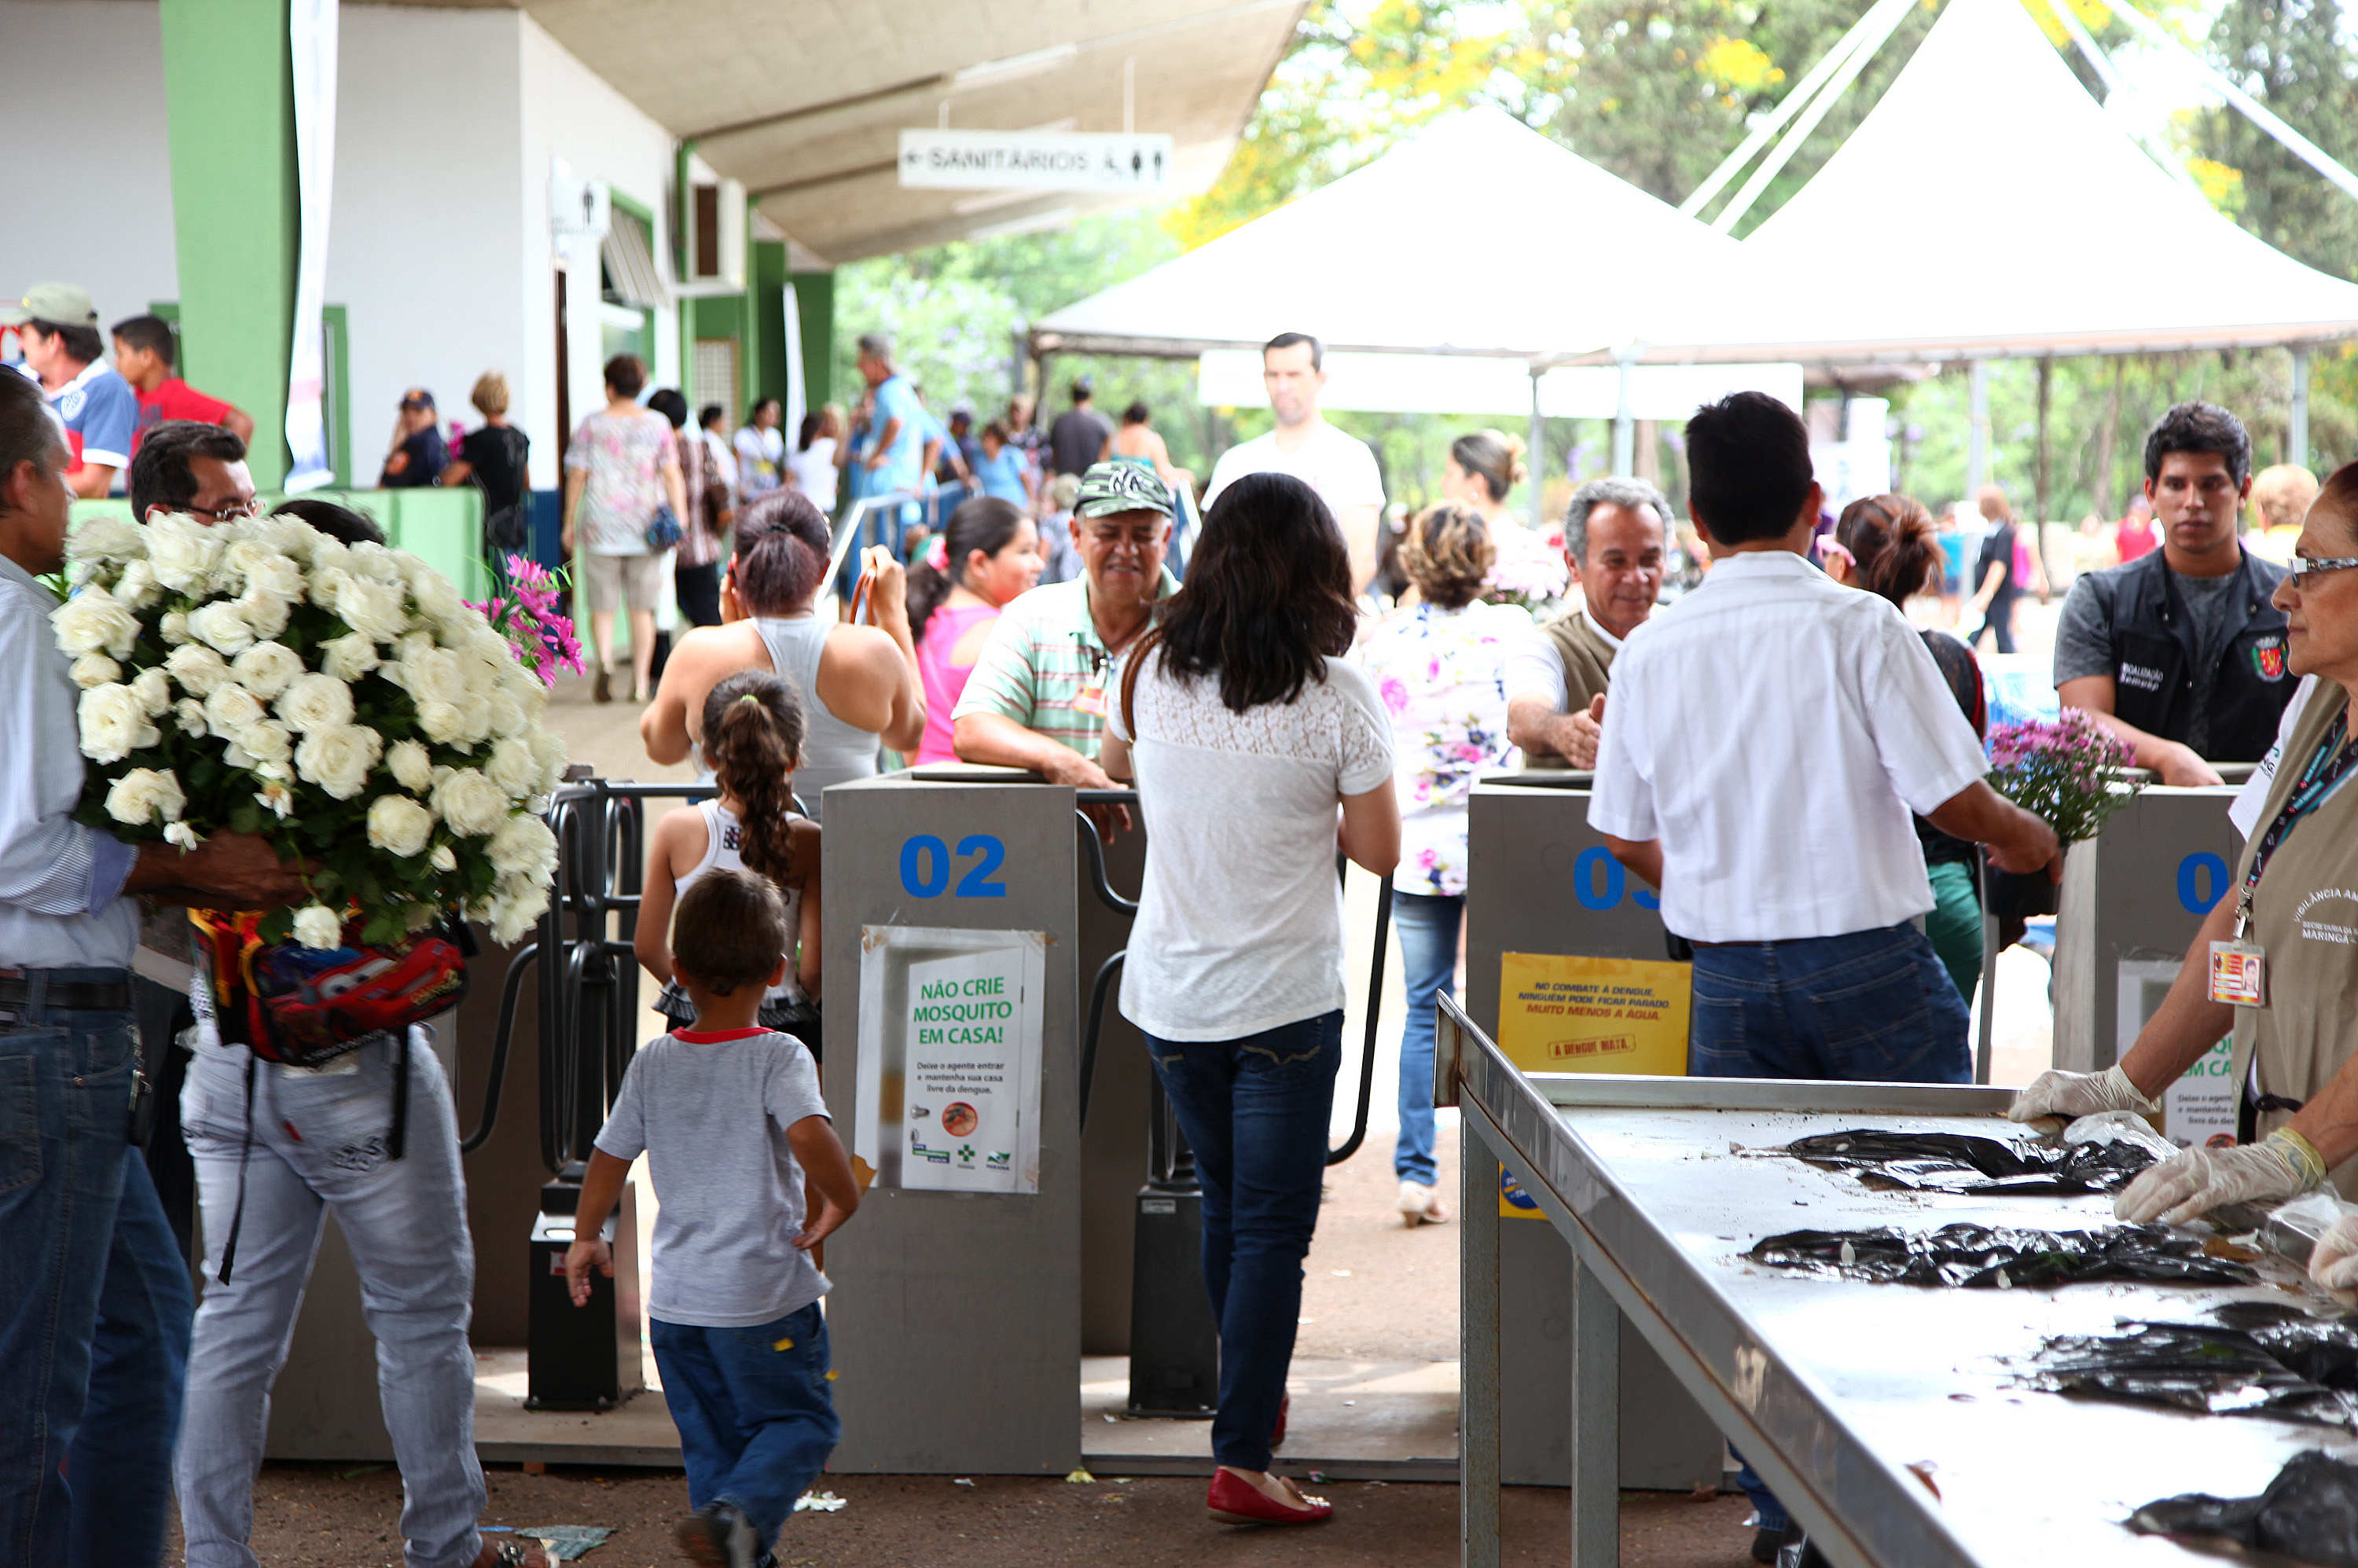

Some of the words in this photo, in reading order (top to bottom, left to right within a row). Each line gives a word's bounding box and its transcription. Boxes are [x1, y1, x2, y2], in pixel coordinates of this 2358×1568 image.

[928, 145, 1089, 170] SANITÁRIOS
[900, 834, 1006, 898] 02
[921, 979, 958, 1000] NÃO
[963, 976, 1005, 996] CRIE
[1535, 982, 1550, 990] NO
[1552, 982, 1600, 993] COMBATE
[1518, 992, 1566, 1002] NINGUÉM
[1569, 995, 1595, 1004] PODE
[1598, 997, 1626, 1006] FICAR
[913, 1001, 1012, 1023] MOSQUITO
[1526, 1004, 1564, 1014] MUITO
[1567, 1006, 1611, 1017] MENOS
[1614, 1009, 1622, 1019] A
[919, 1028, 943, 1045] EM
[948, 1026, 1003, 1044] CASA!
[1555, 1045, 1562, 1056] A
[1564, 1041, 1598, 1056] DENGUE
[946, 1063, 975, 1071] agente
[2209, 1060, 2232, 1077] CA
[957, 1085, 992, 1095] dengue.
